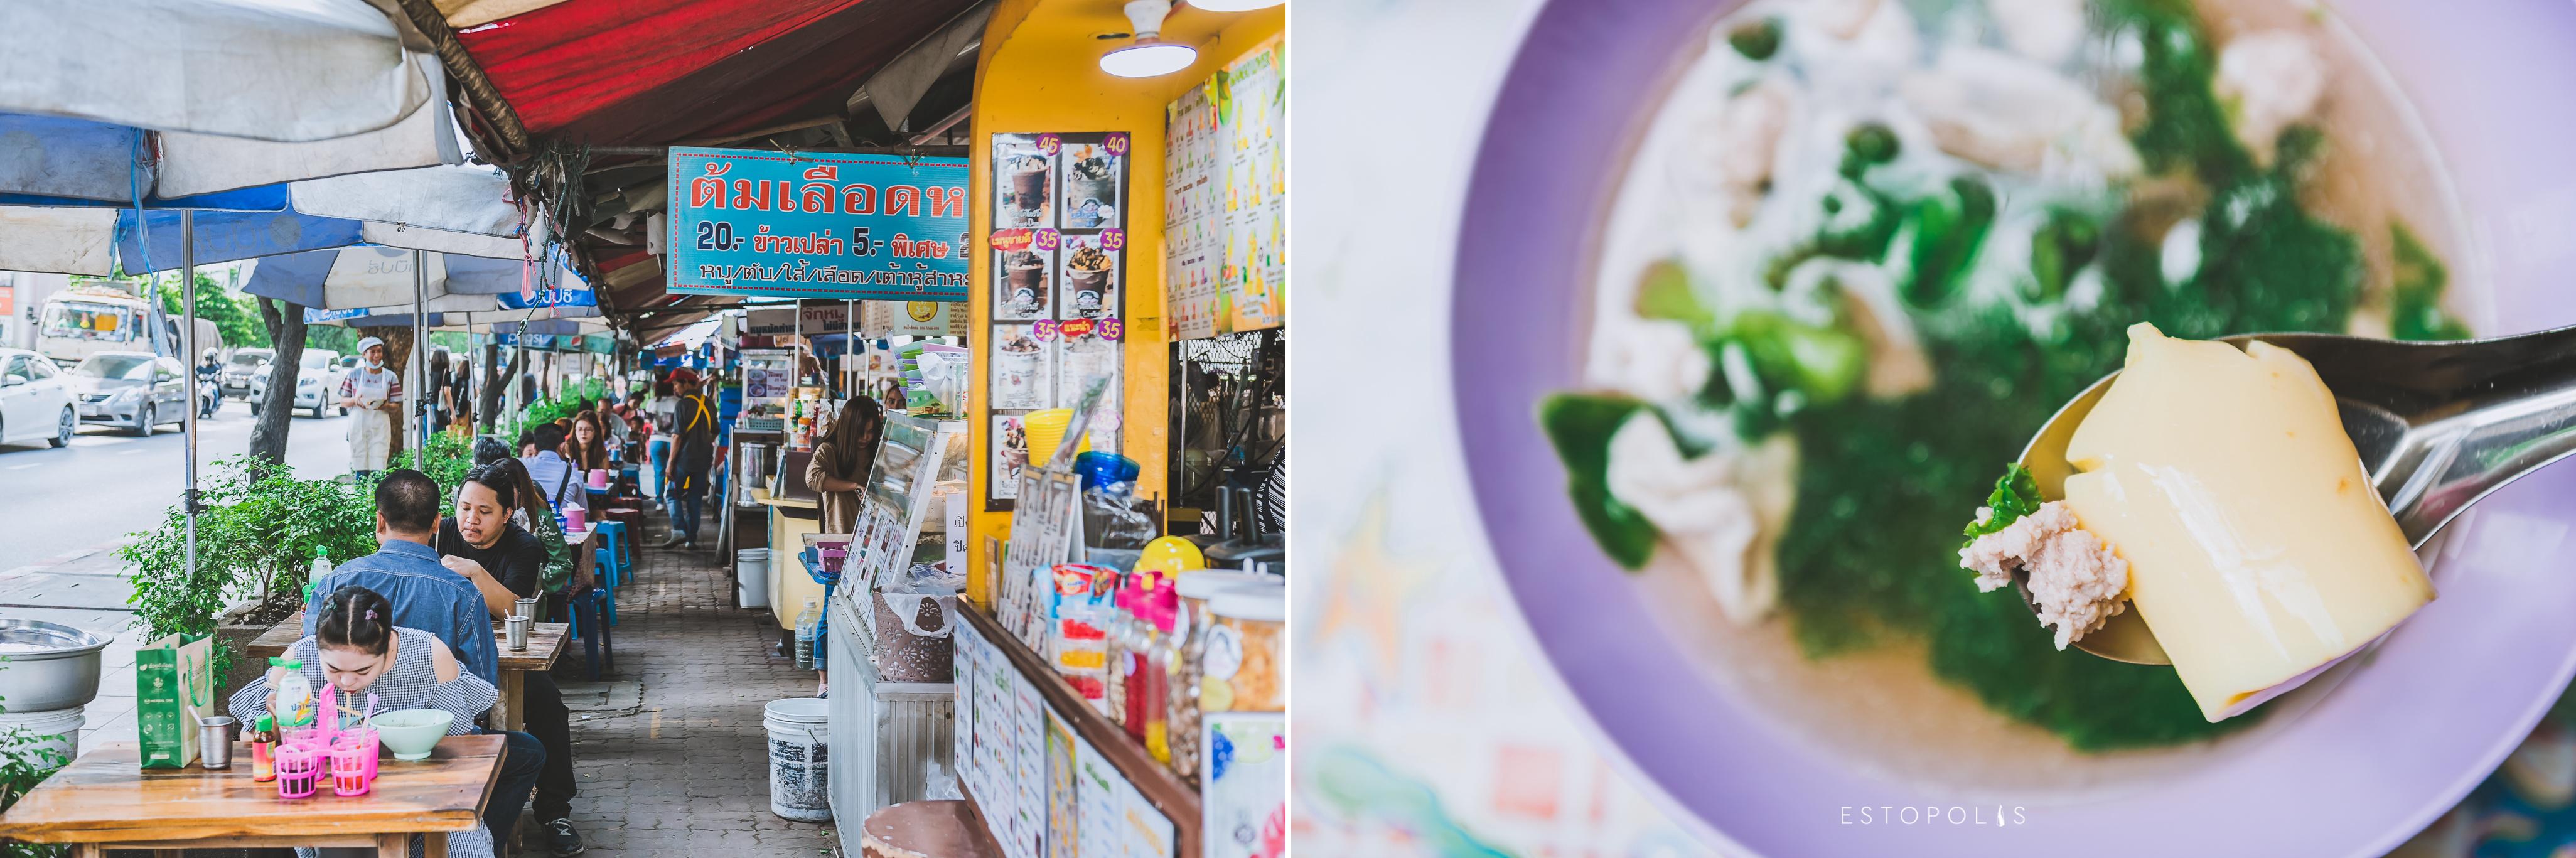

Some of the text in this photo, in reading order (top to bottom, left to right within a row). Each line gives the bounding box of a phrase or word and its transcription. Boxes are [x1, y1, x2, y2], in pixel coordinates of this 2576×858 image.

[1039, 137, 1058, 153] 45
[1107, 137, 1126, 152] 40
[697, 221, 744, 252] 20.-
[753, 225, 844, 256] ข้าวเปล่า
[852, 227, 884, 257] 5.-
[891, 233, 949, 259] พิเศษ
[1038, 230, 1058, 247] 35
[1103, 231, 1123, 249] 35
[1036, 322, 1056, 338] 35
[1100, 321, 1120, 338] 35
[508, 333, 543, 345] ppsi
